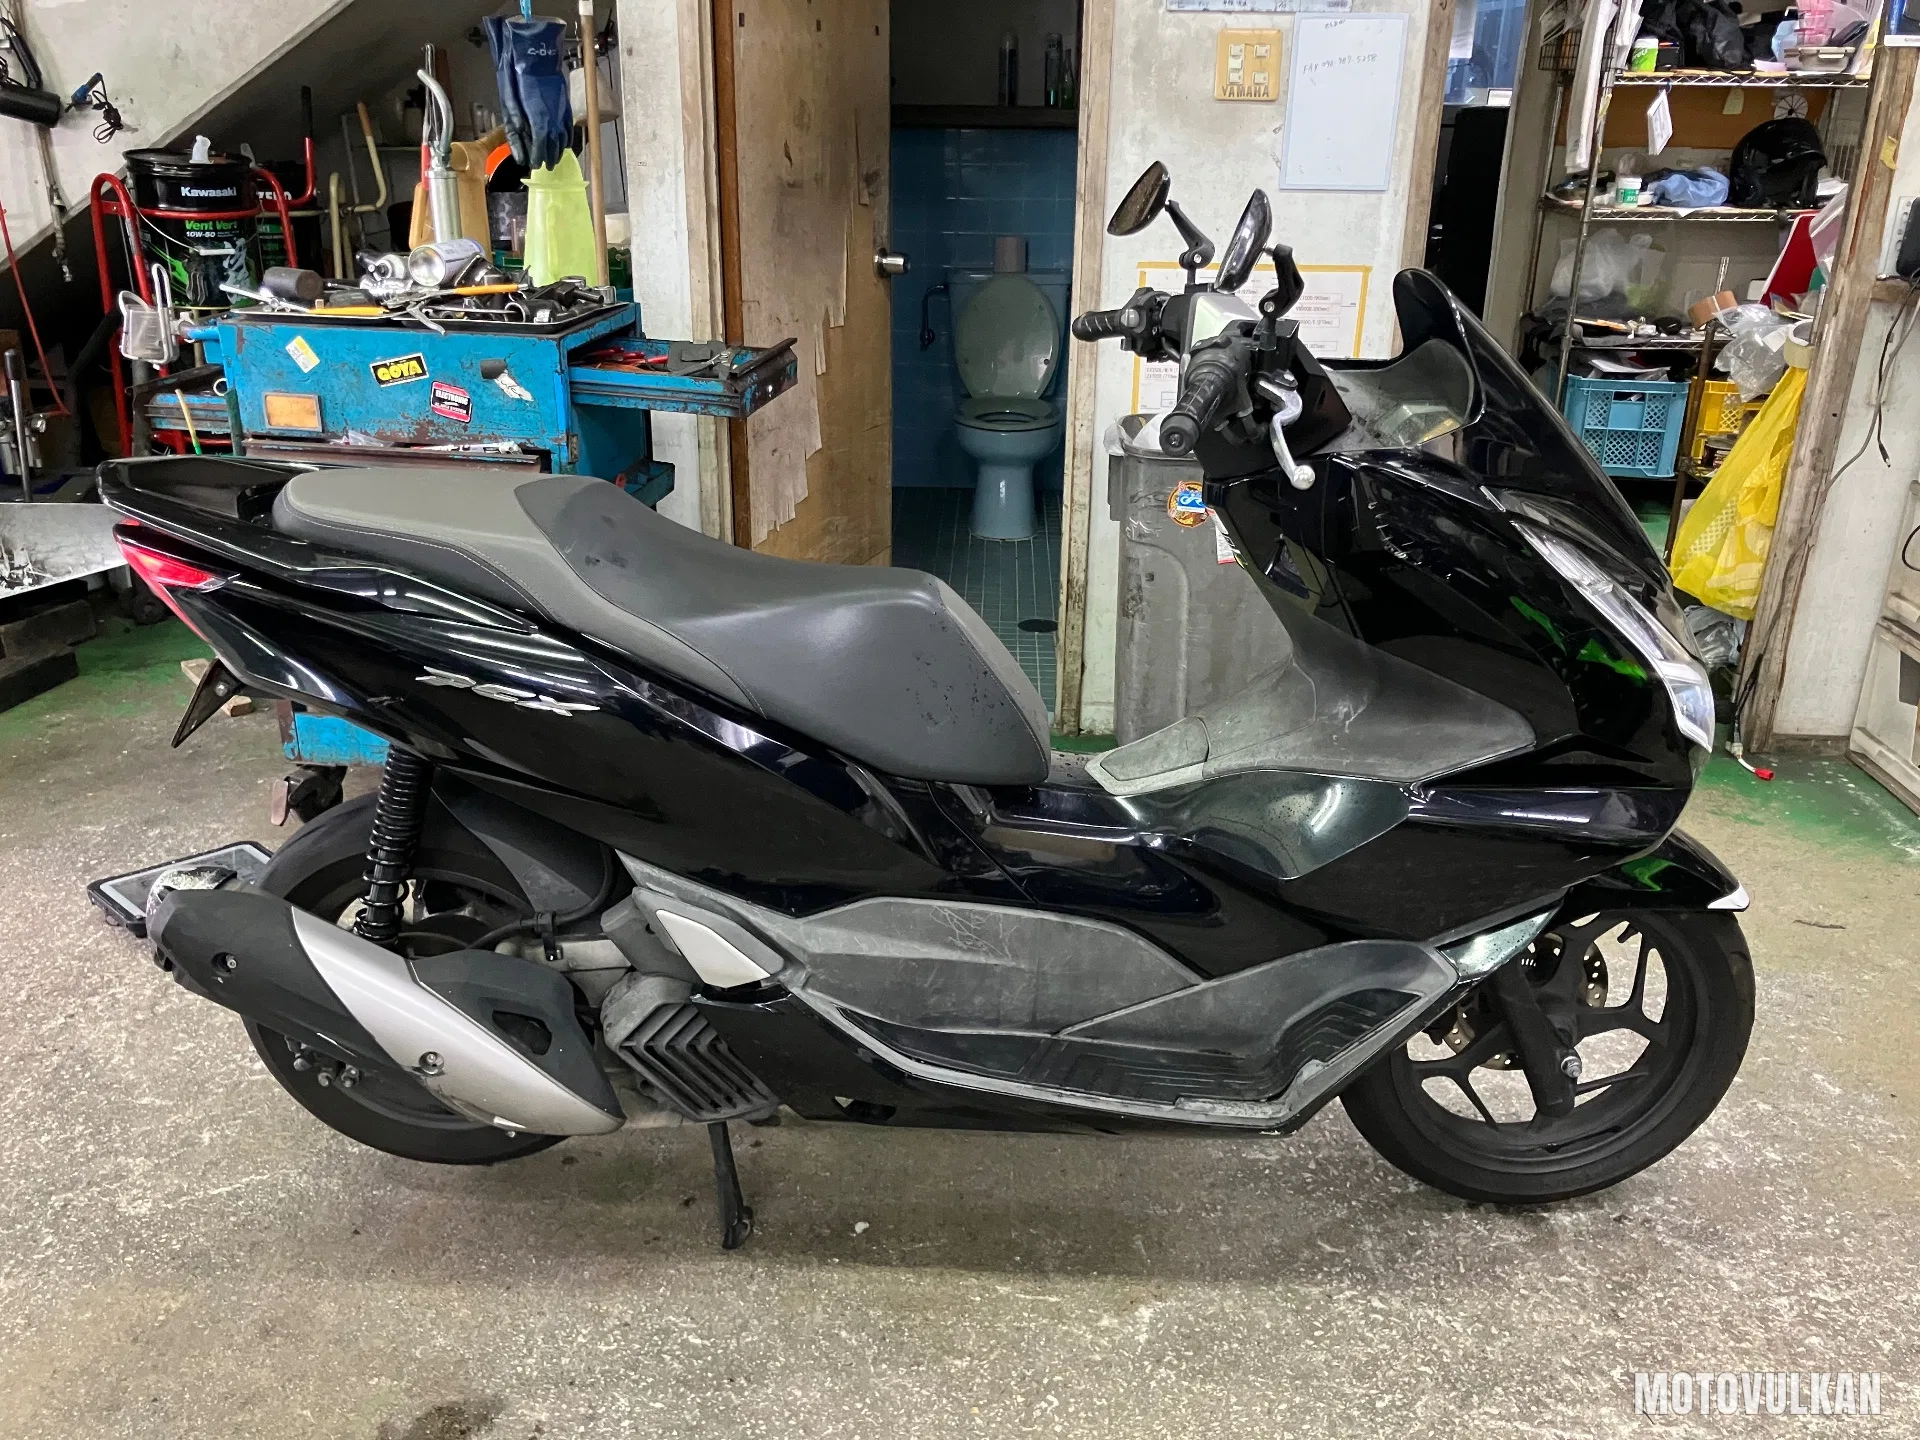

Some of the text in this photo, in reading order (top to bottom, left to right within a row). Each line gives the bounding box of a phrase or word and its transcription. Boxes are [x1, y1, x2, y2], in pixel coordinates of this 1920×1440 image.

[1221, 85, 1269, 98] YAMAHA
[181, 186, 237, 197] Kawasaki
[185, 220, 213, 231] Vent
[377, 360, 422, 381] GOYA
[435, 390, 469, 405] ELECTRONIC
